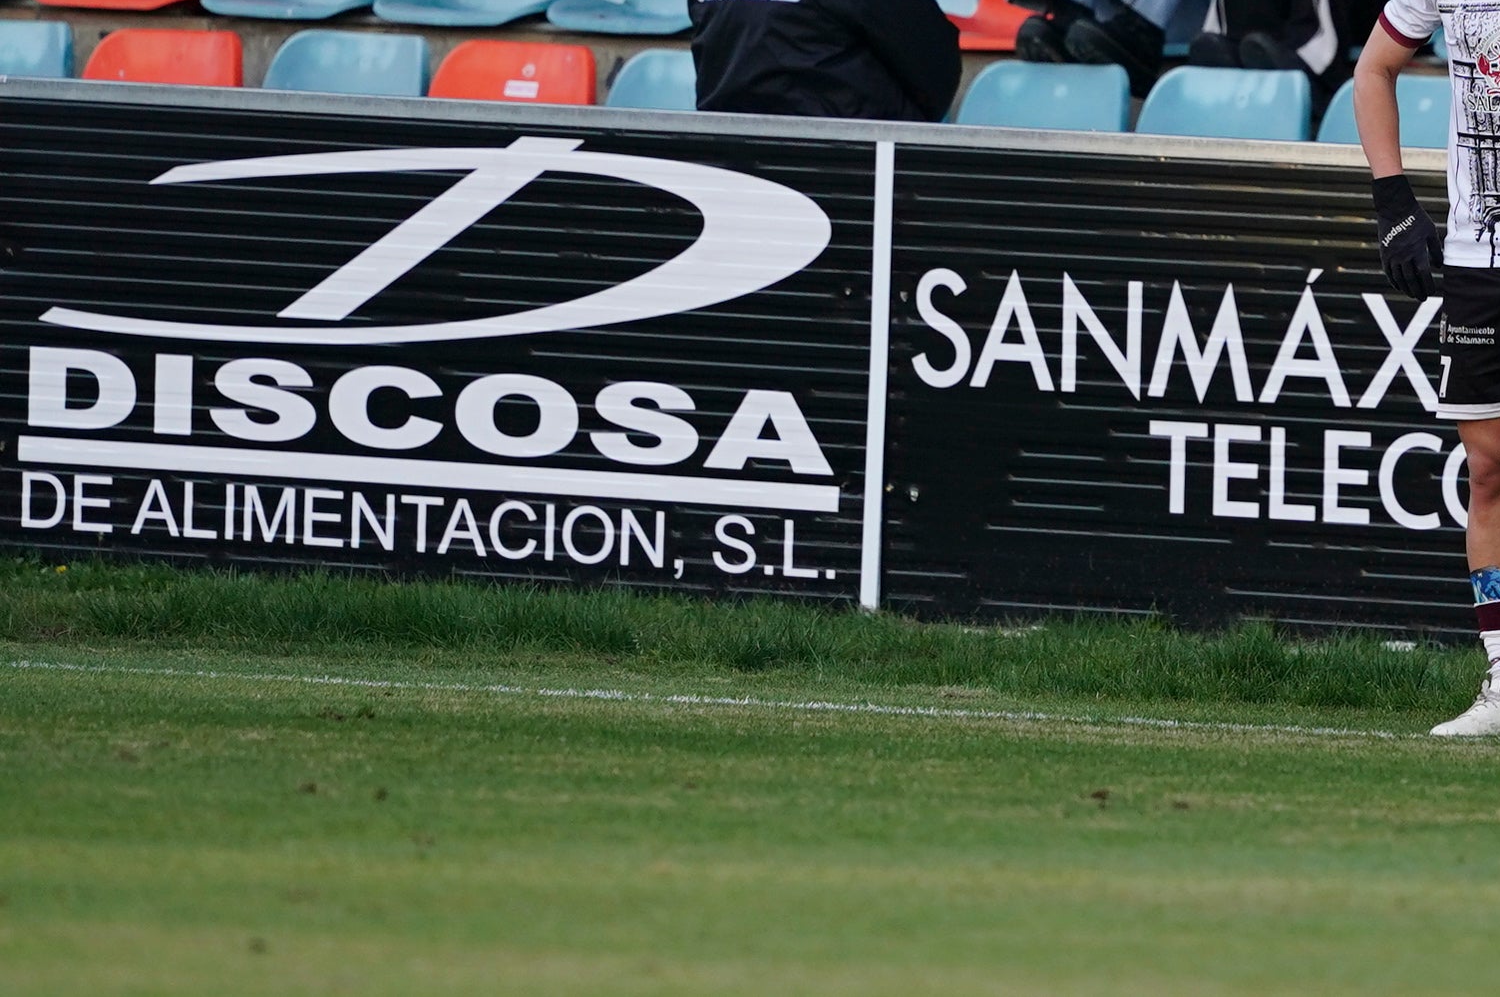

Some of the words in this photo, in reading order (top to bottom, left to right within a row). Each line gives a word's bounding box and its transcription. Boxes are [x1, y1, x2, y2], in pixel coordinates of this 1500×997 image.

[1381, 215, 1416, 247] uhlsport
[1456, 335, 1495, 345] Salamanca
[28, 346, 834, 475] DISCOSA
[21, 471, 113, 533] DE
[131, 478, 684, 580] ALIMENTACION,
[712, 515, 837, 580] S.L.
